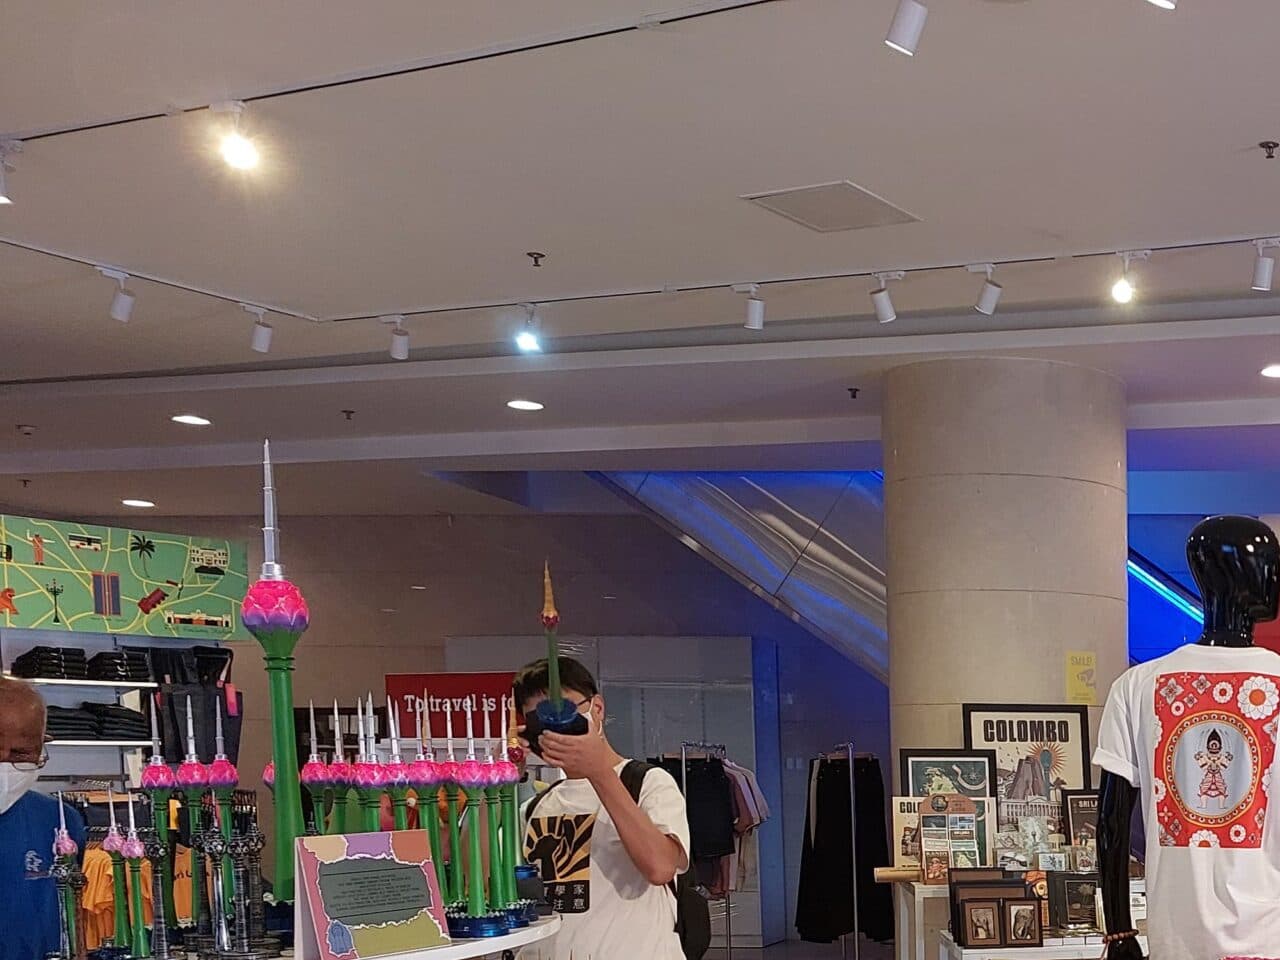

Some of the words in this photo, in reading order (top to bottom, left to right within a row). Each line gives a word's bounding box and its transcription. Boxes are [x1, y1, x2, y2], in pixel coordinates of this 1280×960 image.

[404, 694, 424, 712] To
[429, 693, 477, 712] travel
[482, 693, 497, 711] is
[983, 719, 1070, 742] COLOMBO
[899, 801, 920, 814] COL
